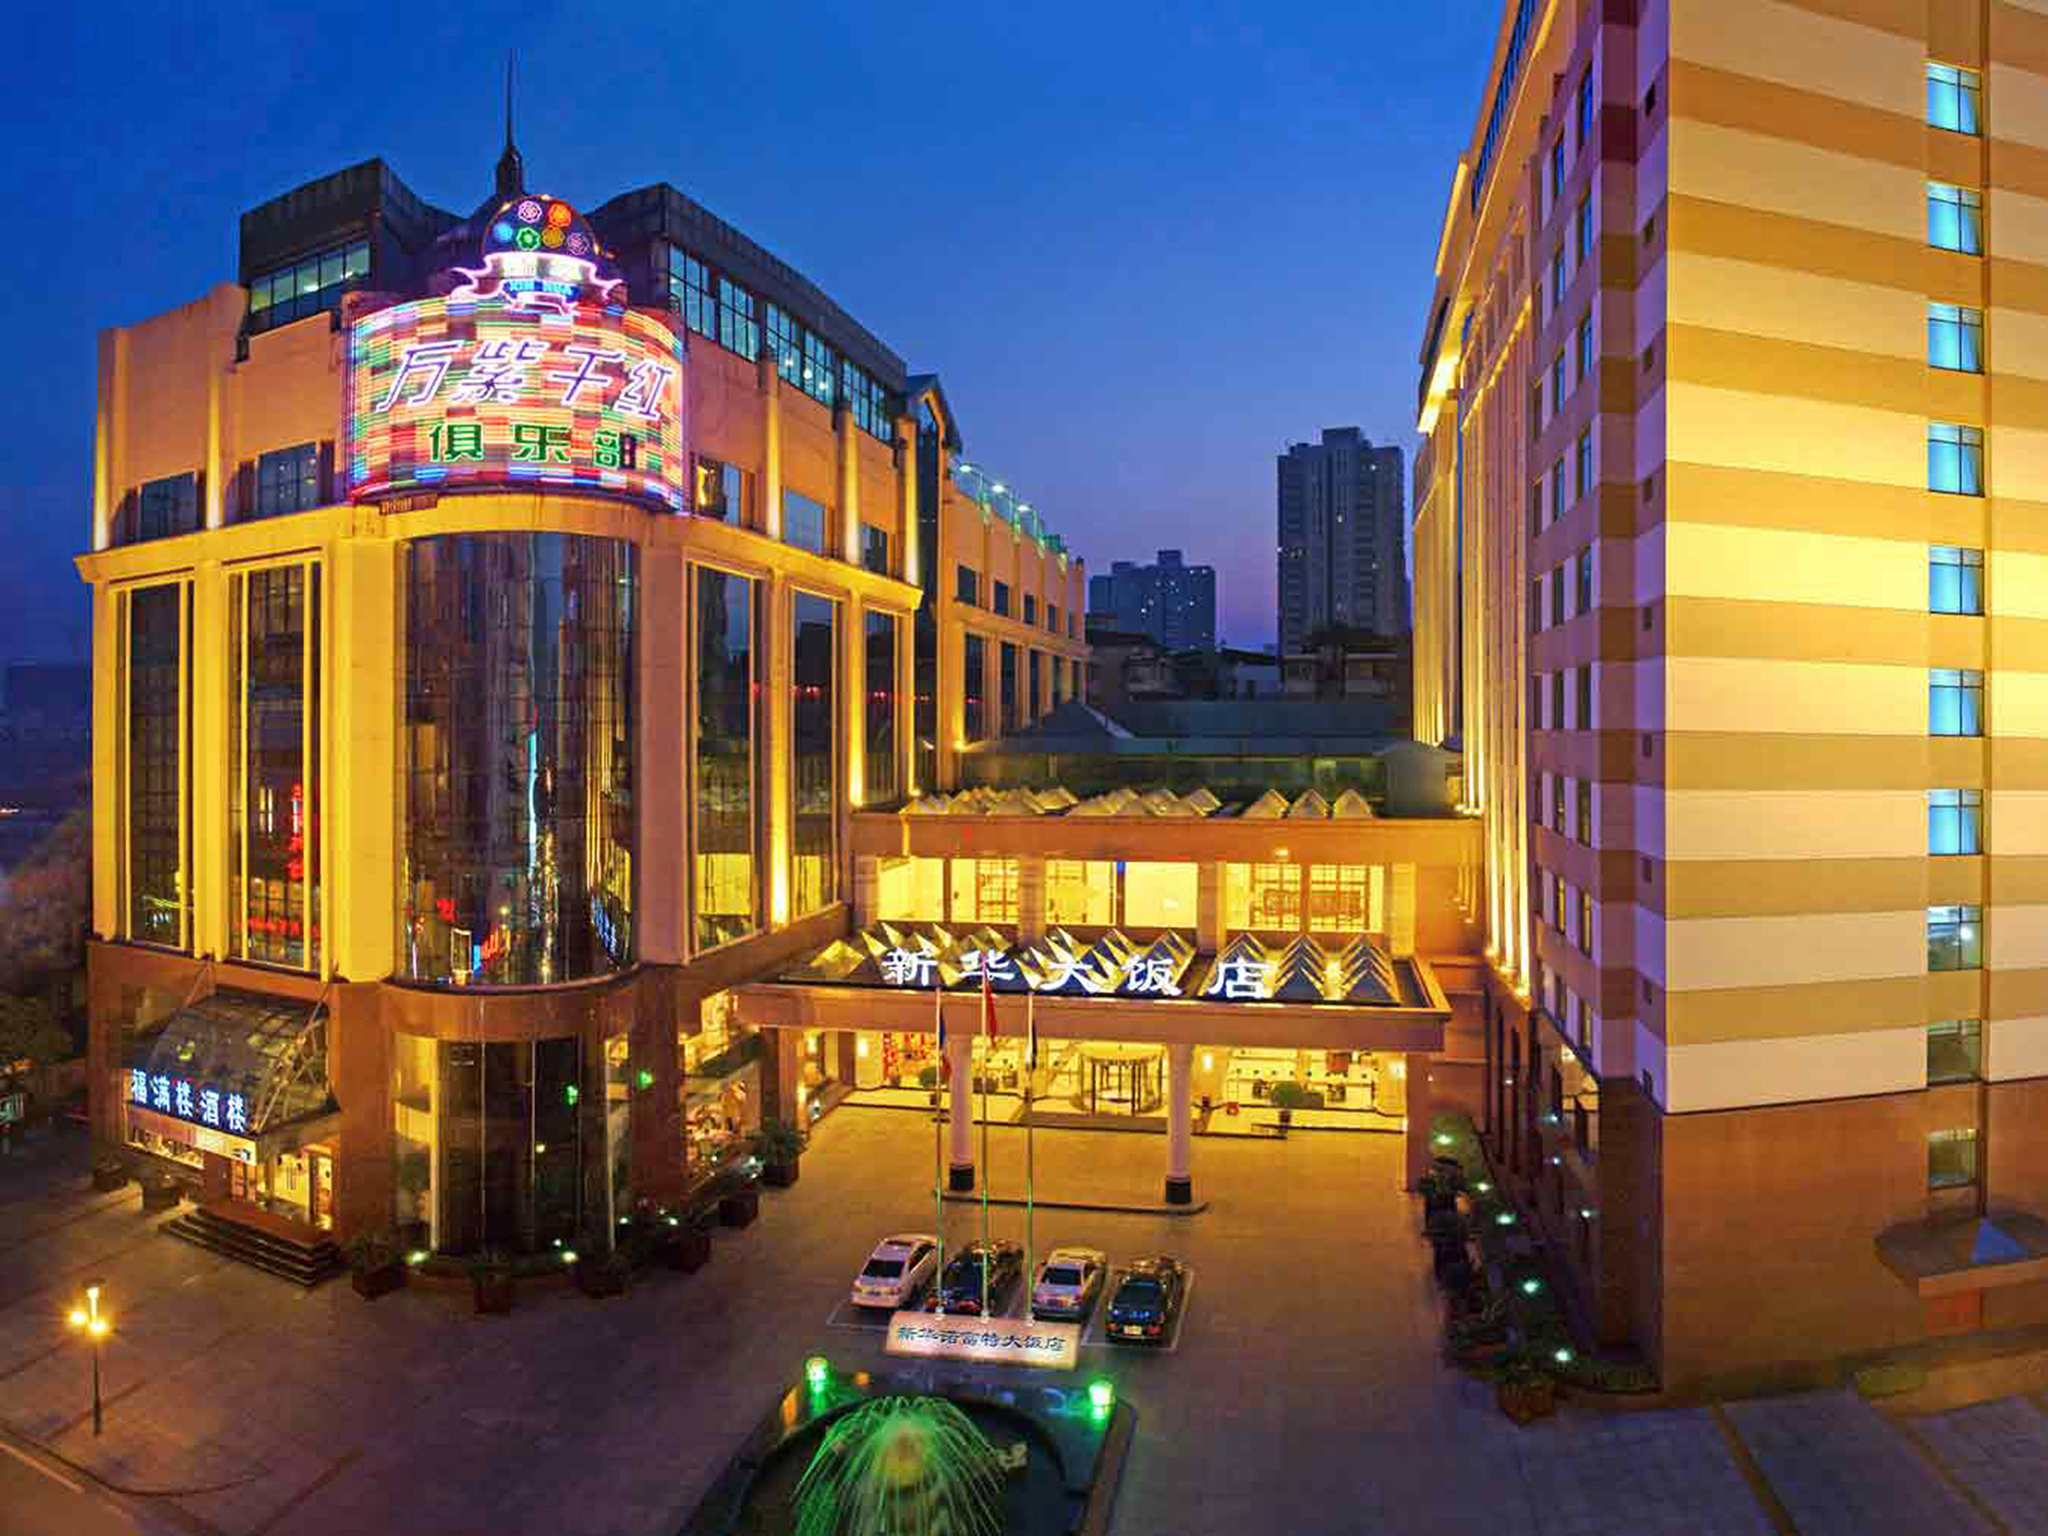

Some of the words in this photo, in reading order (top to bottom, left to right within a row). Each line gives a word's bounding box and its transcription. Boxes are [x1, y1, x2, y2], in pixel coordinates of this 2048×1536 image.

[375, 339, 676, 420] 万紫千红
[429, 422, 638, 470] 俱乐部
[882, 947, 1273, 998] 新华大饭店
